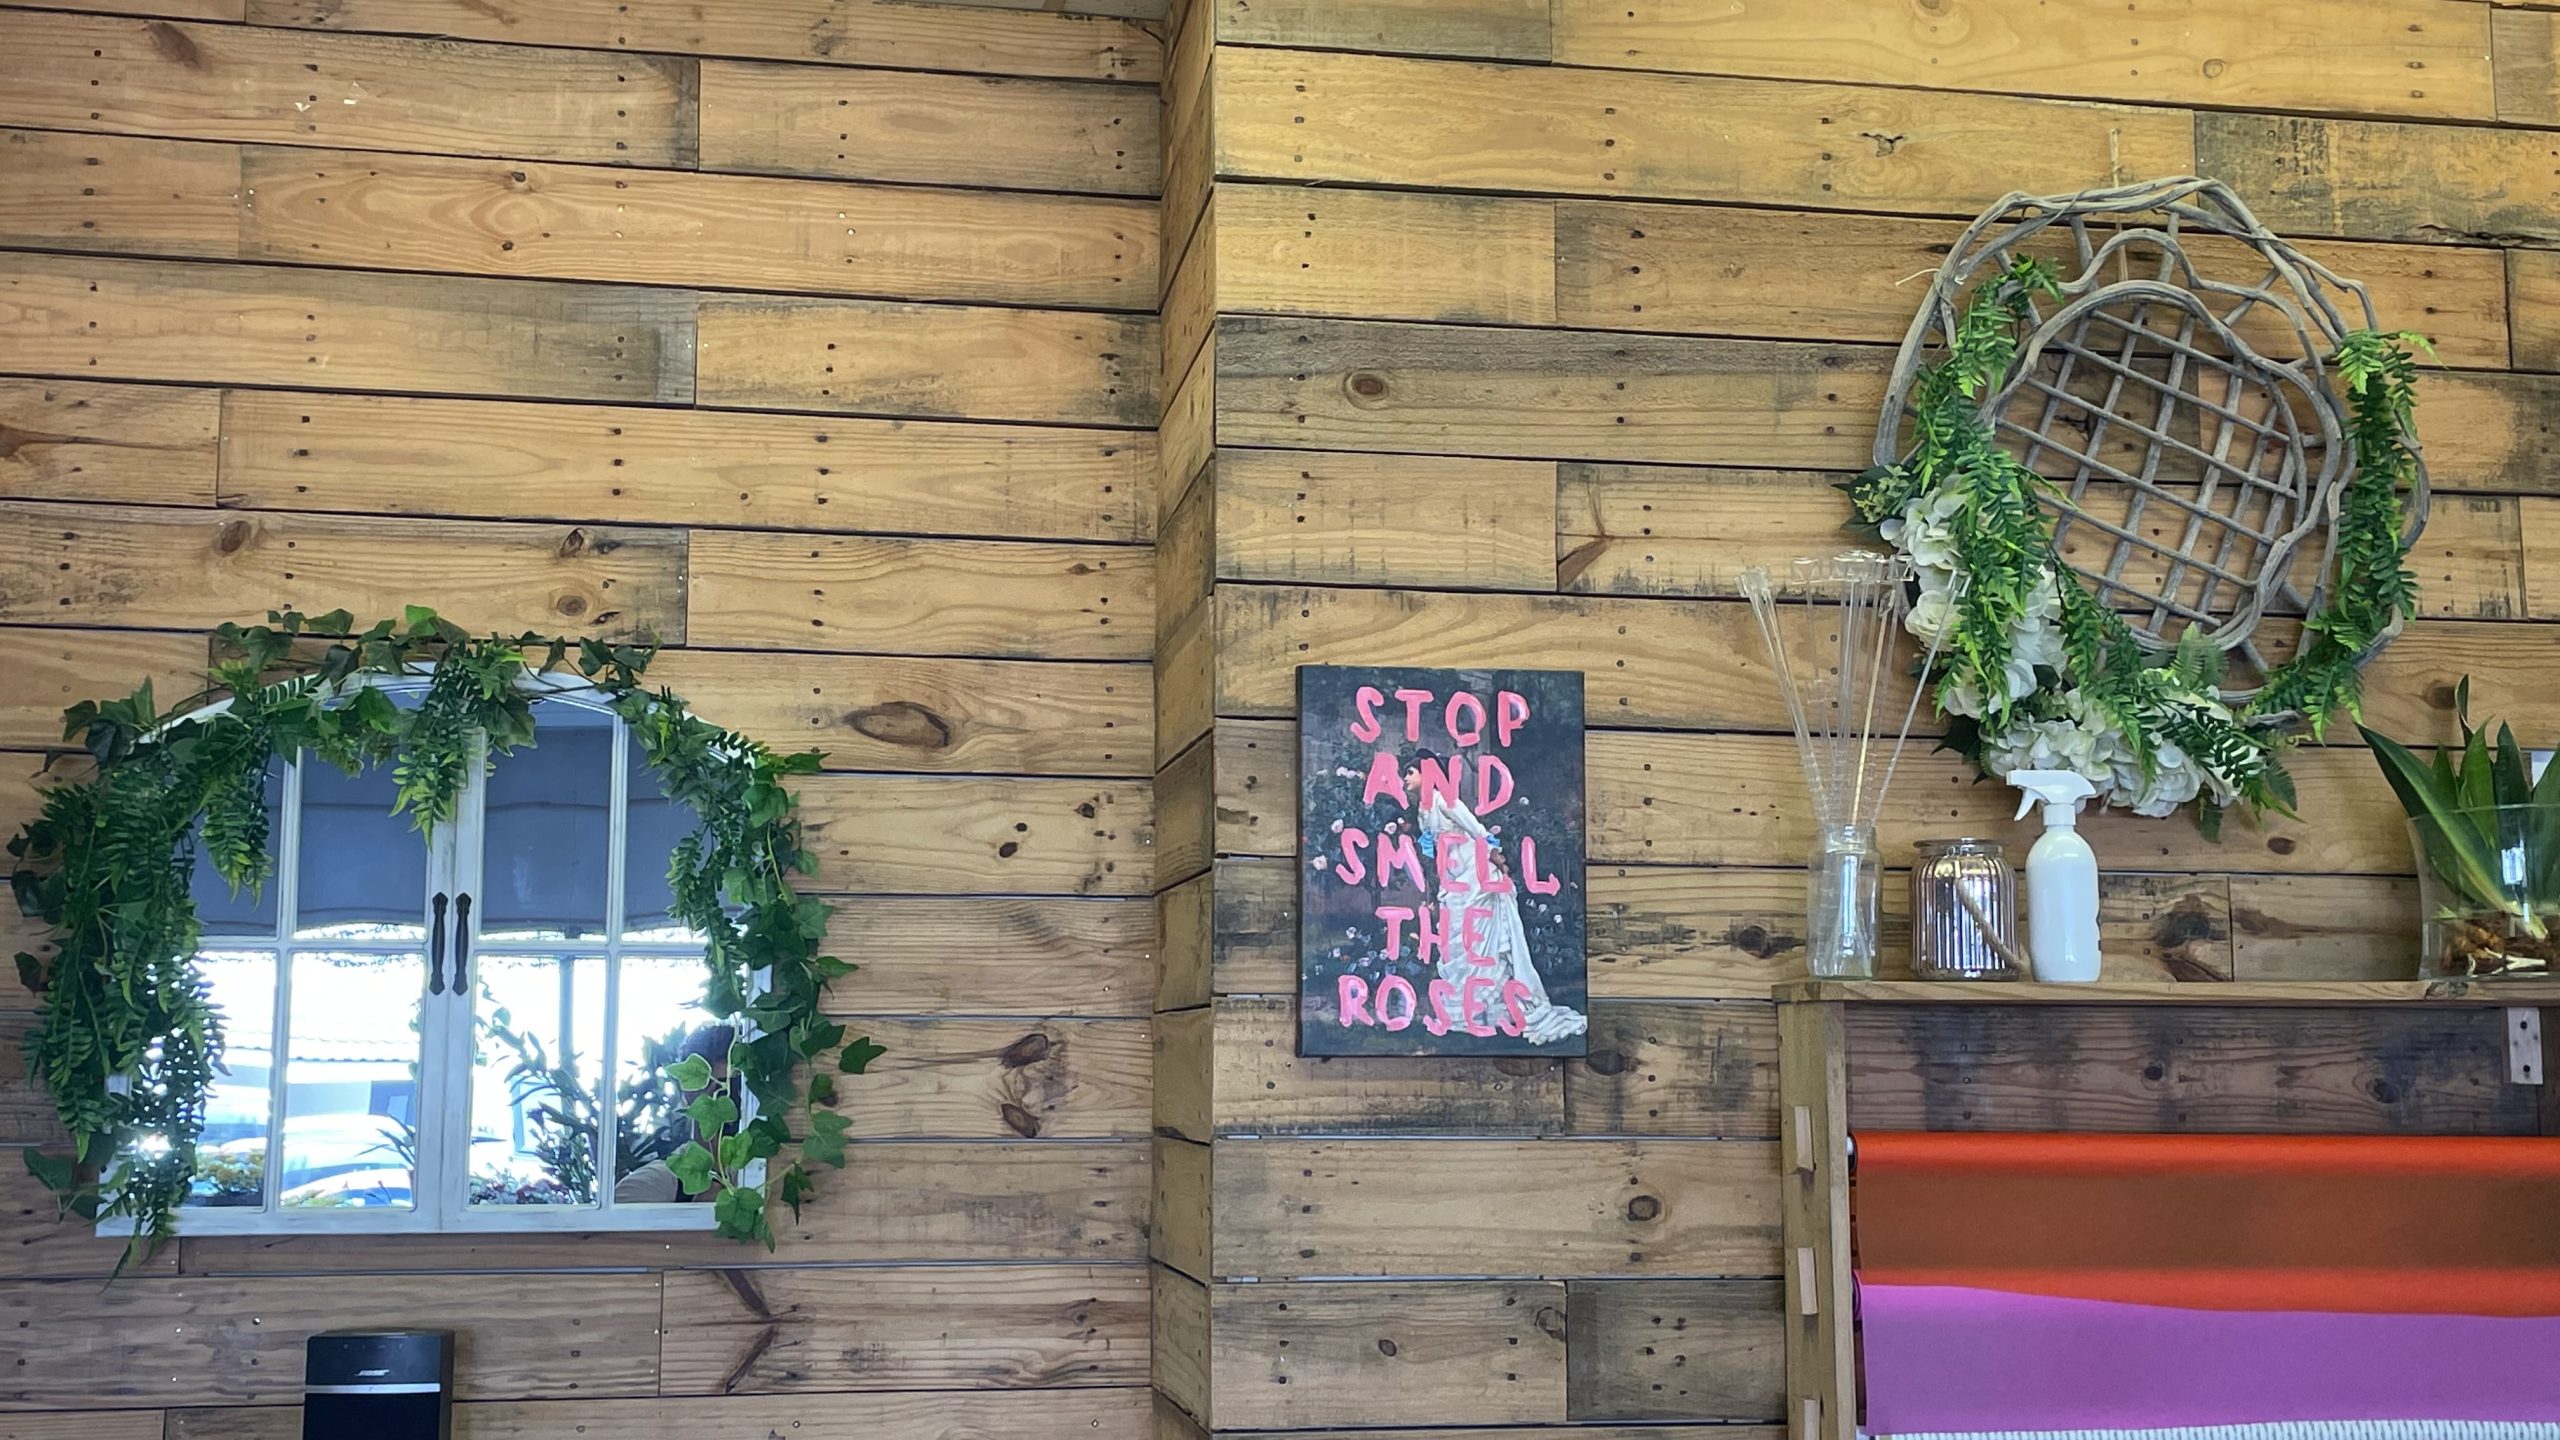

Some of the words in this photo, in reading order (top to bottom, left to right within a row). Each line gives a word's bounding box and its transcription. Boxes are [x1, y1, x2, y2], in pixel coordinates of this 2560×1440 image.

[1351, 686, 1530, 747] STOP
[1363, 752, 1515, 815] AND
[1335, 827, 1561, 896] SMELL
[1375, 906, 1496, 967] THE
[1337, 974, 1528, 1037] ROSES
